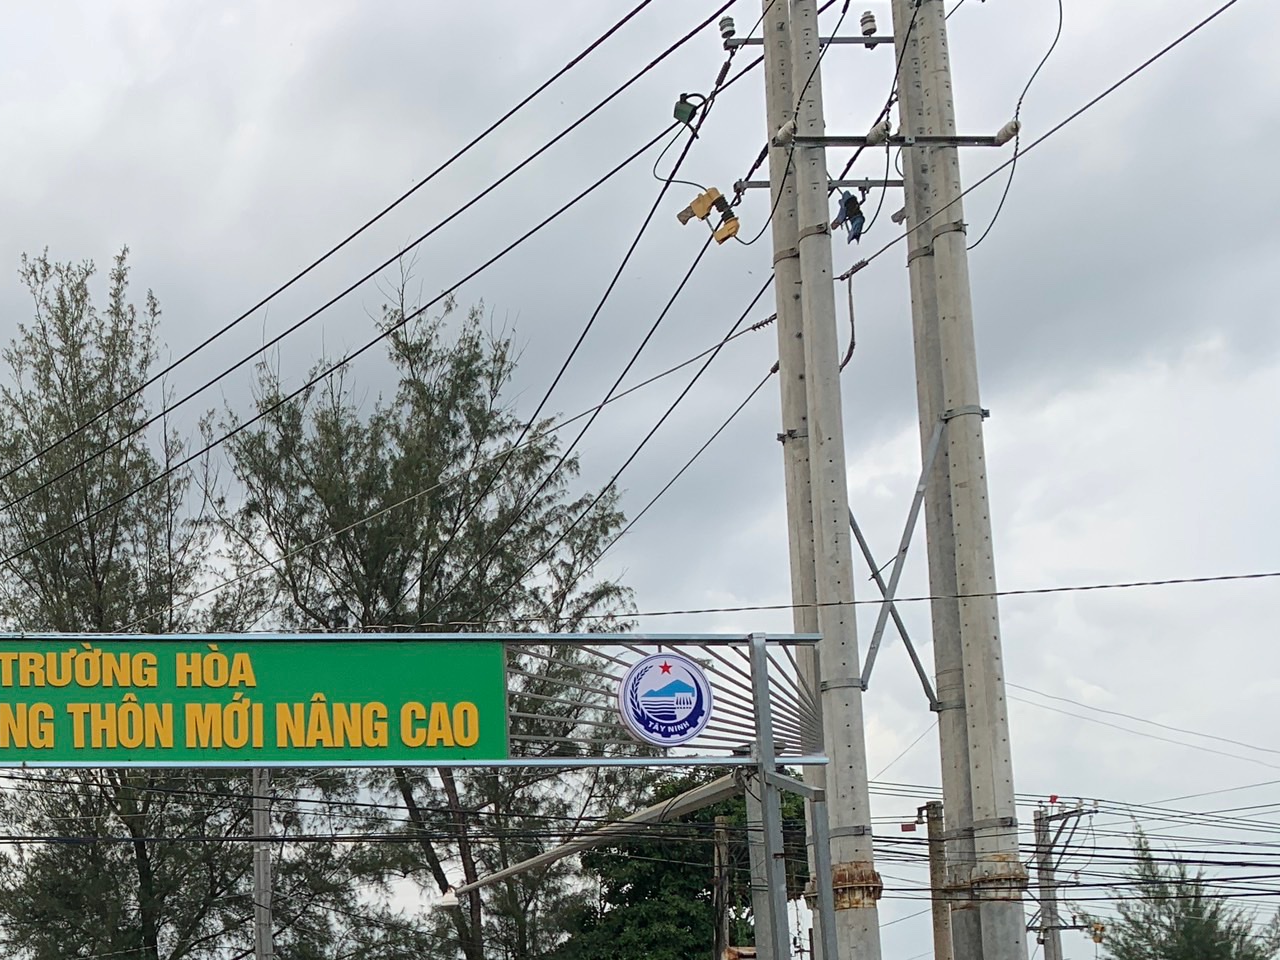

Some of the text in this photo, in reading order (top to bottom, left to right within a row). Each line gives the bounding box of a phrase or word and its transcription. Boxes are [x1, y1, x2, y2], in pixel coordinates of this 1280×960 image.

[176, 643, 257, 688] HÒA
[66, 692, 174, 749] THÔN
[185, 691, 265, 749] MỚI
[276, 691, 388, 748] NÂNG
[400, 701, 480, 748] CAO
[648, 720, 690, 733] TÂY NINH
